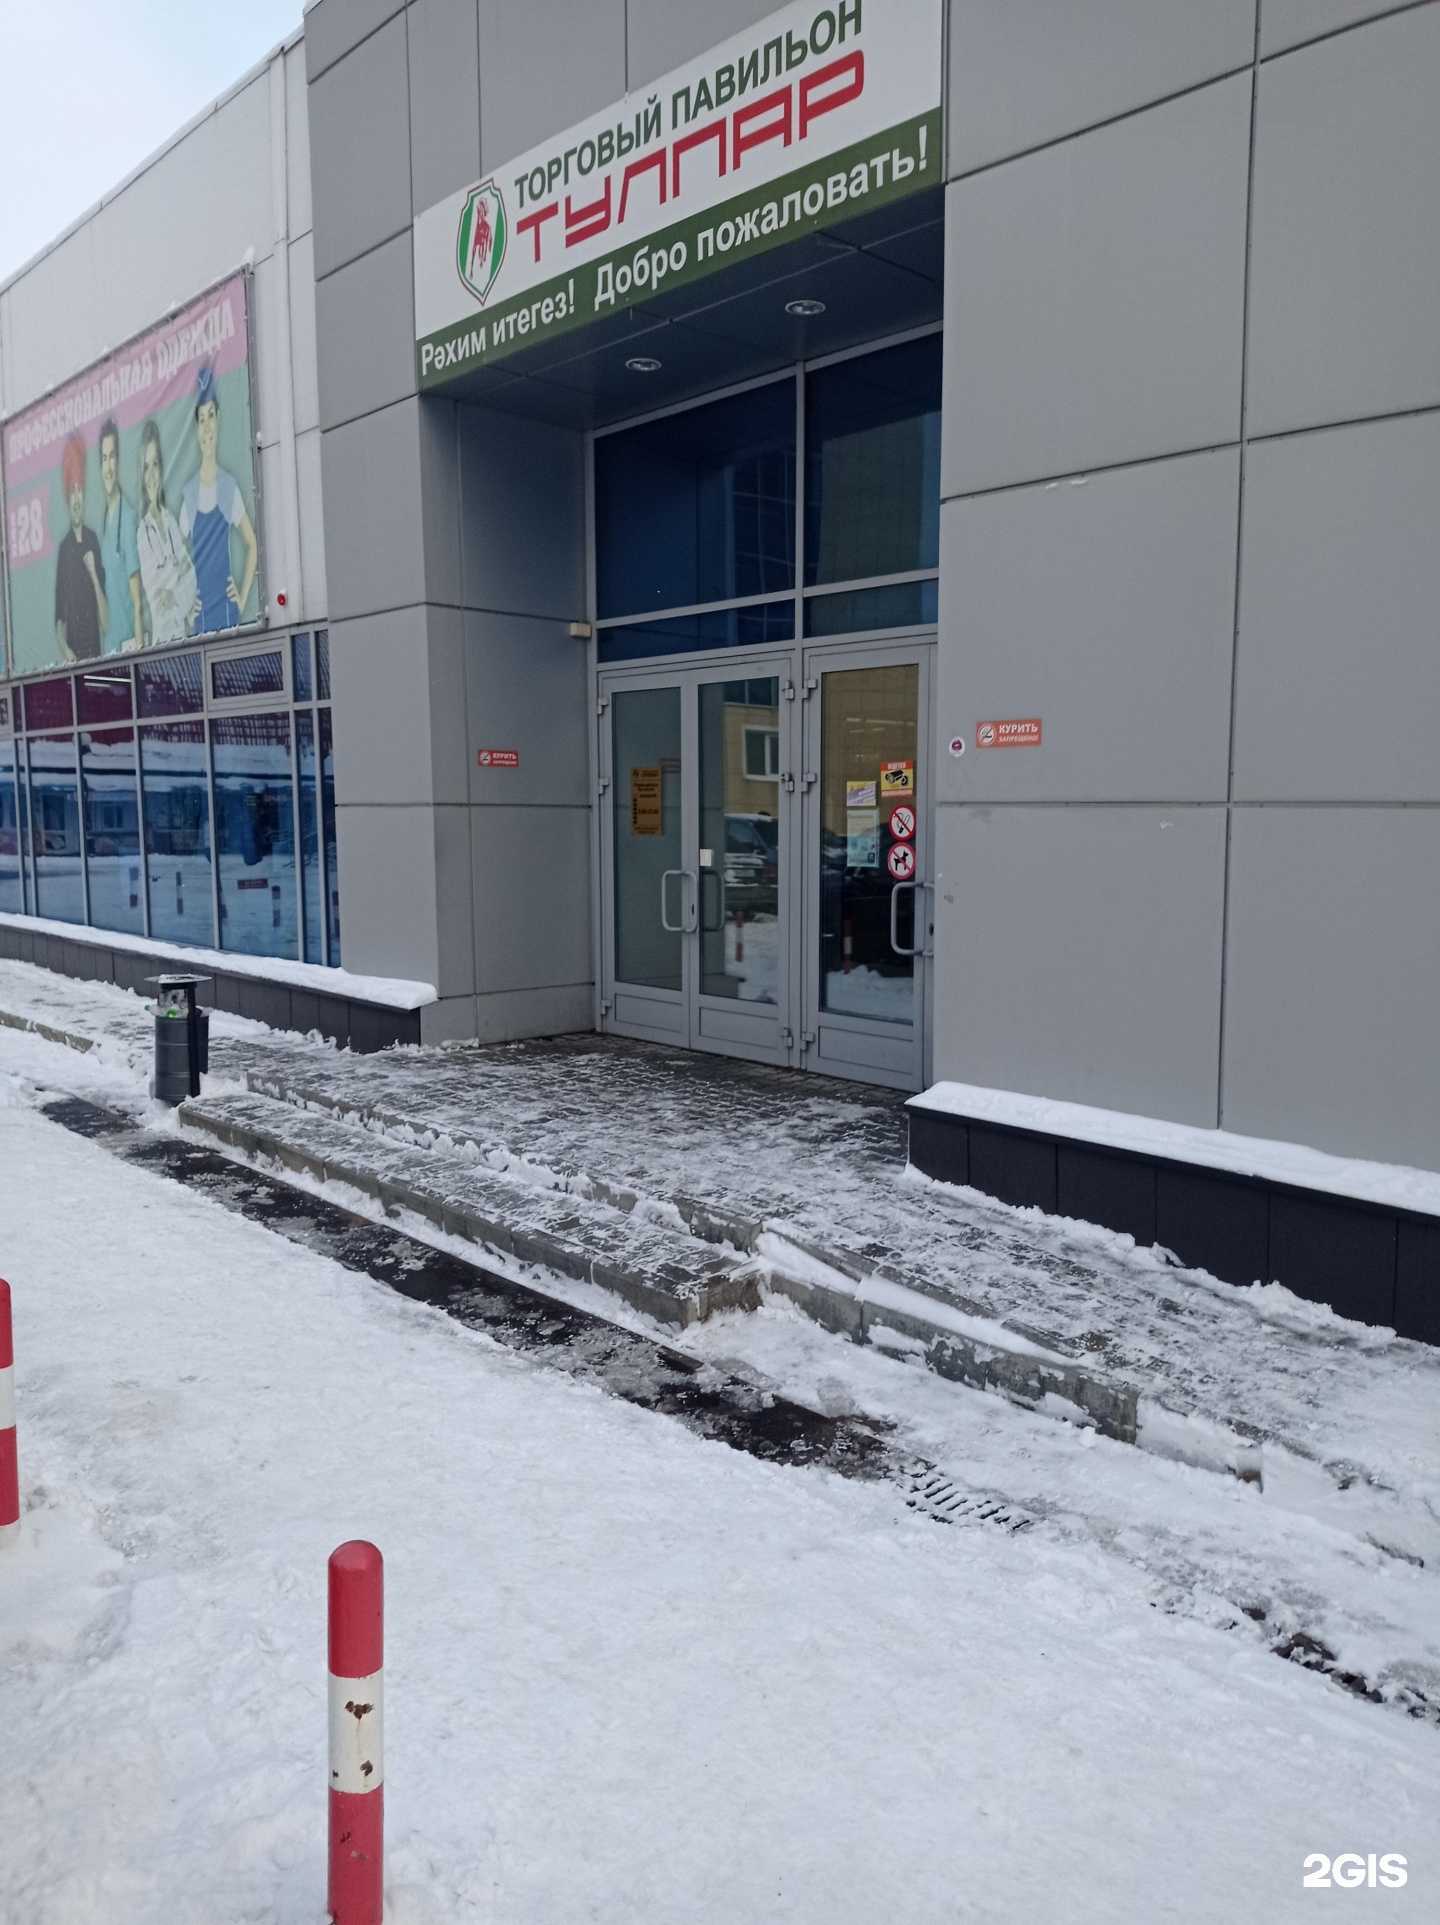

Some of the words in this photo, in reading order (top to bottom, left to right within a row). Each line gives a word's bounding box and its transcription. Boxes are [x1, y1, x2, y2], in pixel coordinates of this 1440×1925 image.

[514, 93, 662, 208] ТОРГОВЫЙ
[672, 0, 862, 130] ПАВИЛЬОН
[516, 49, 865, 264] ТУЛПАР
[421, 326, 487, 377] Рәхим
[493, 278, 575, 346] итегез!
[594, 240, 688, 312] Добро
[697, 124, 928, 262] пожаловать!
[999, 722, 1039, 735] КУРИТЬ
